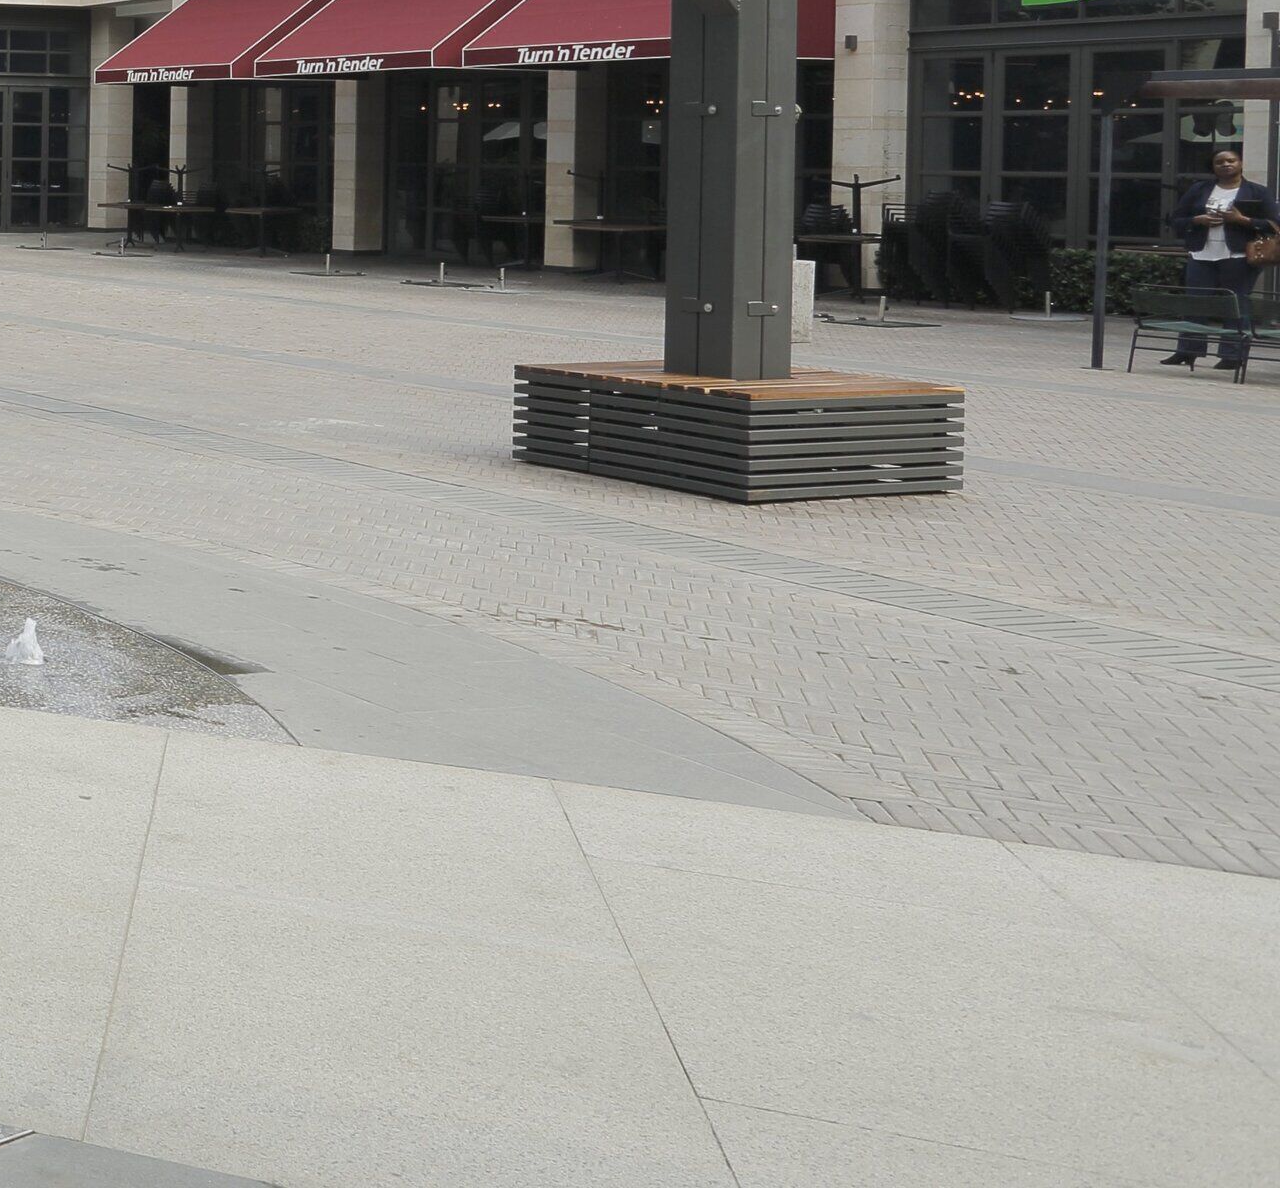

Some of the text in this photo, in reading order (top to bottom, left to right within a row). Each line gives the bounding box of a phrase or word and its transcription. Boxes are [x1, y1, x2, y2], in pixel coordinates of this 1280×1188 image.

[517, 47, 554, 64] Turn
[572, 43, 635, 61] Tender
[296, 60, 324, 74] Turn
[337, 56, 384, 72] Tender
[126, 69, 148, 82] Turn
[158, 67, 195, 81] Tender
